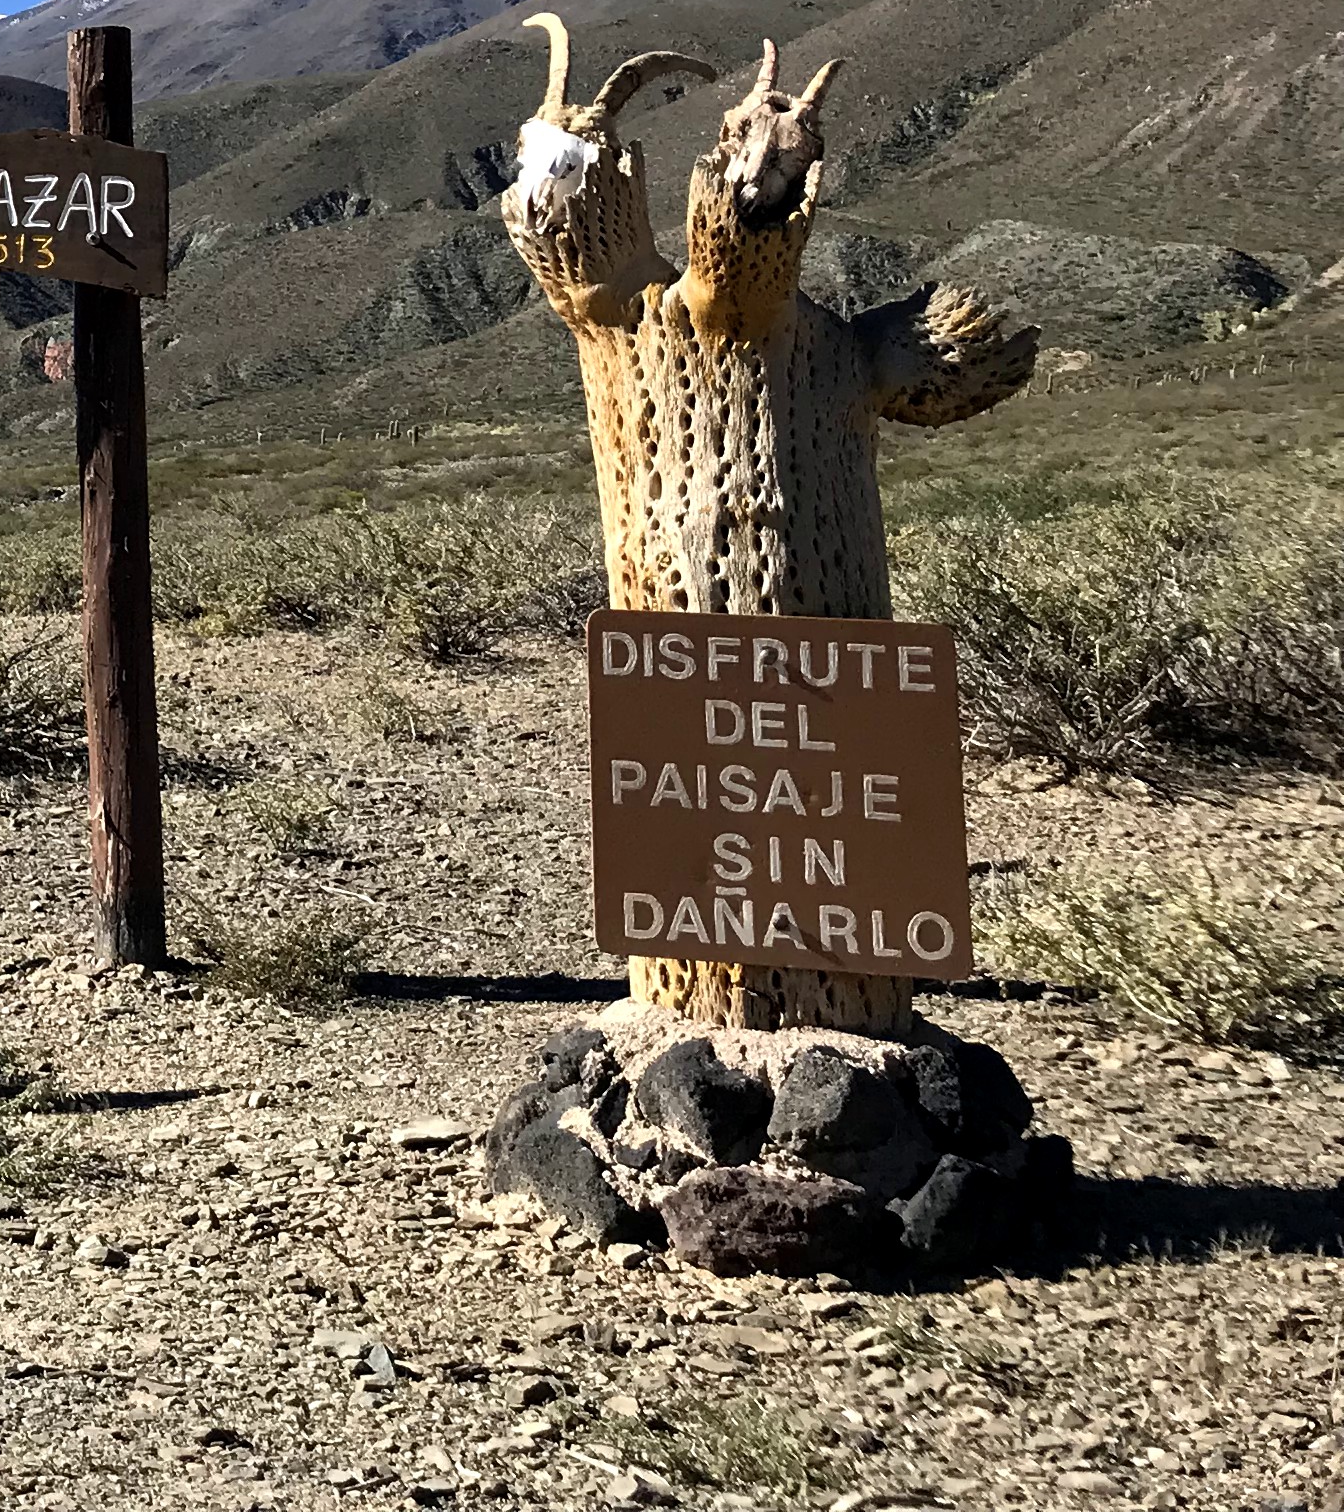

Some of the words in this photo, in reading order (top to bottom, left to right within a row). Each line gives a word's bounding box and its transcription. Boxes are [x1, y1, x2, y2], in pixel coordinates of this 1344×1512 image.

[601, 630, 937, 693] DISFRUTE
[704, 698, 837, 752] DEL
[610, 759, 902, 823] PAISAJE
[713, 832, 847, 887] SIN
[623, 885, 955, 962] DAÑARLO
